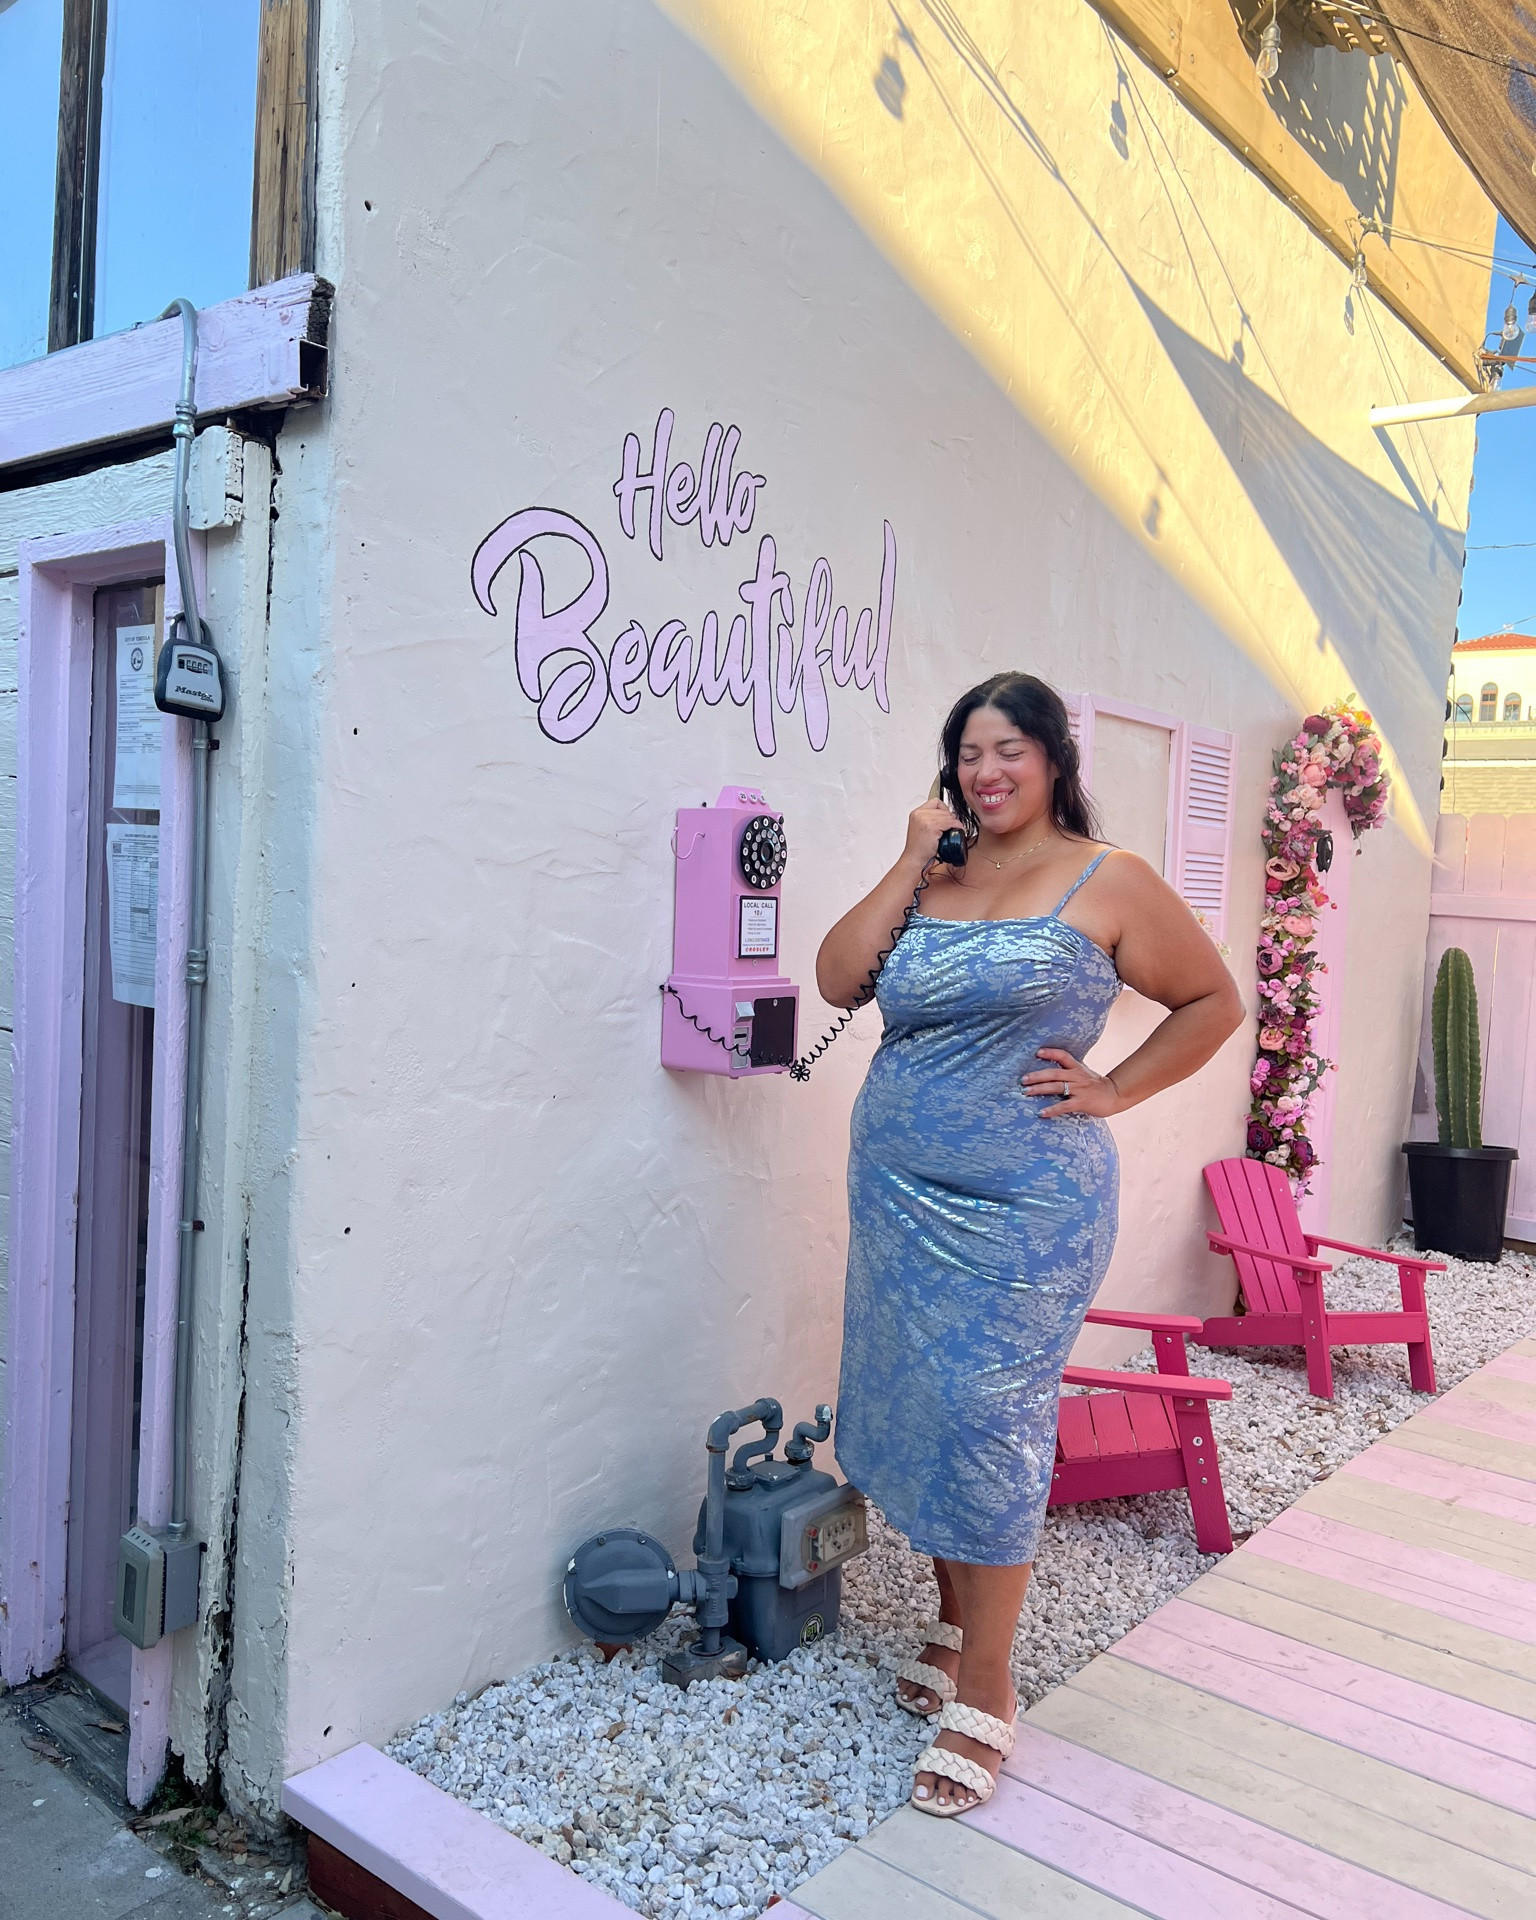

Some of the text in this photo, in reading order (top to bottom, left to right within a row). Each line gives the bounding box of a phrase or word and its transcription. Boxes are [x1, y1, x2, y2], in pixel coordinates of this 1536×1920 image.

[613, 407, 767, 561] Hello
[175, 685, 212, 698] Master
[471, 506, 896, 757] Beautiful
